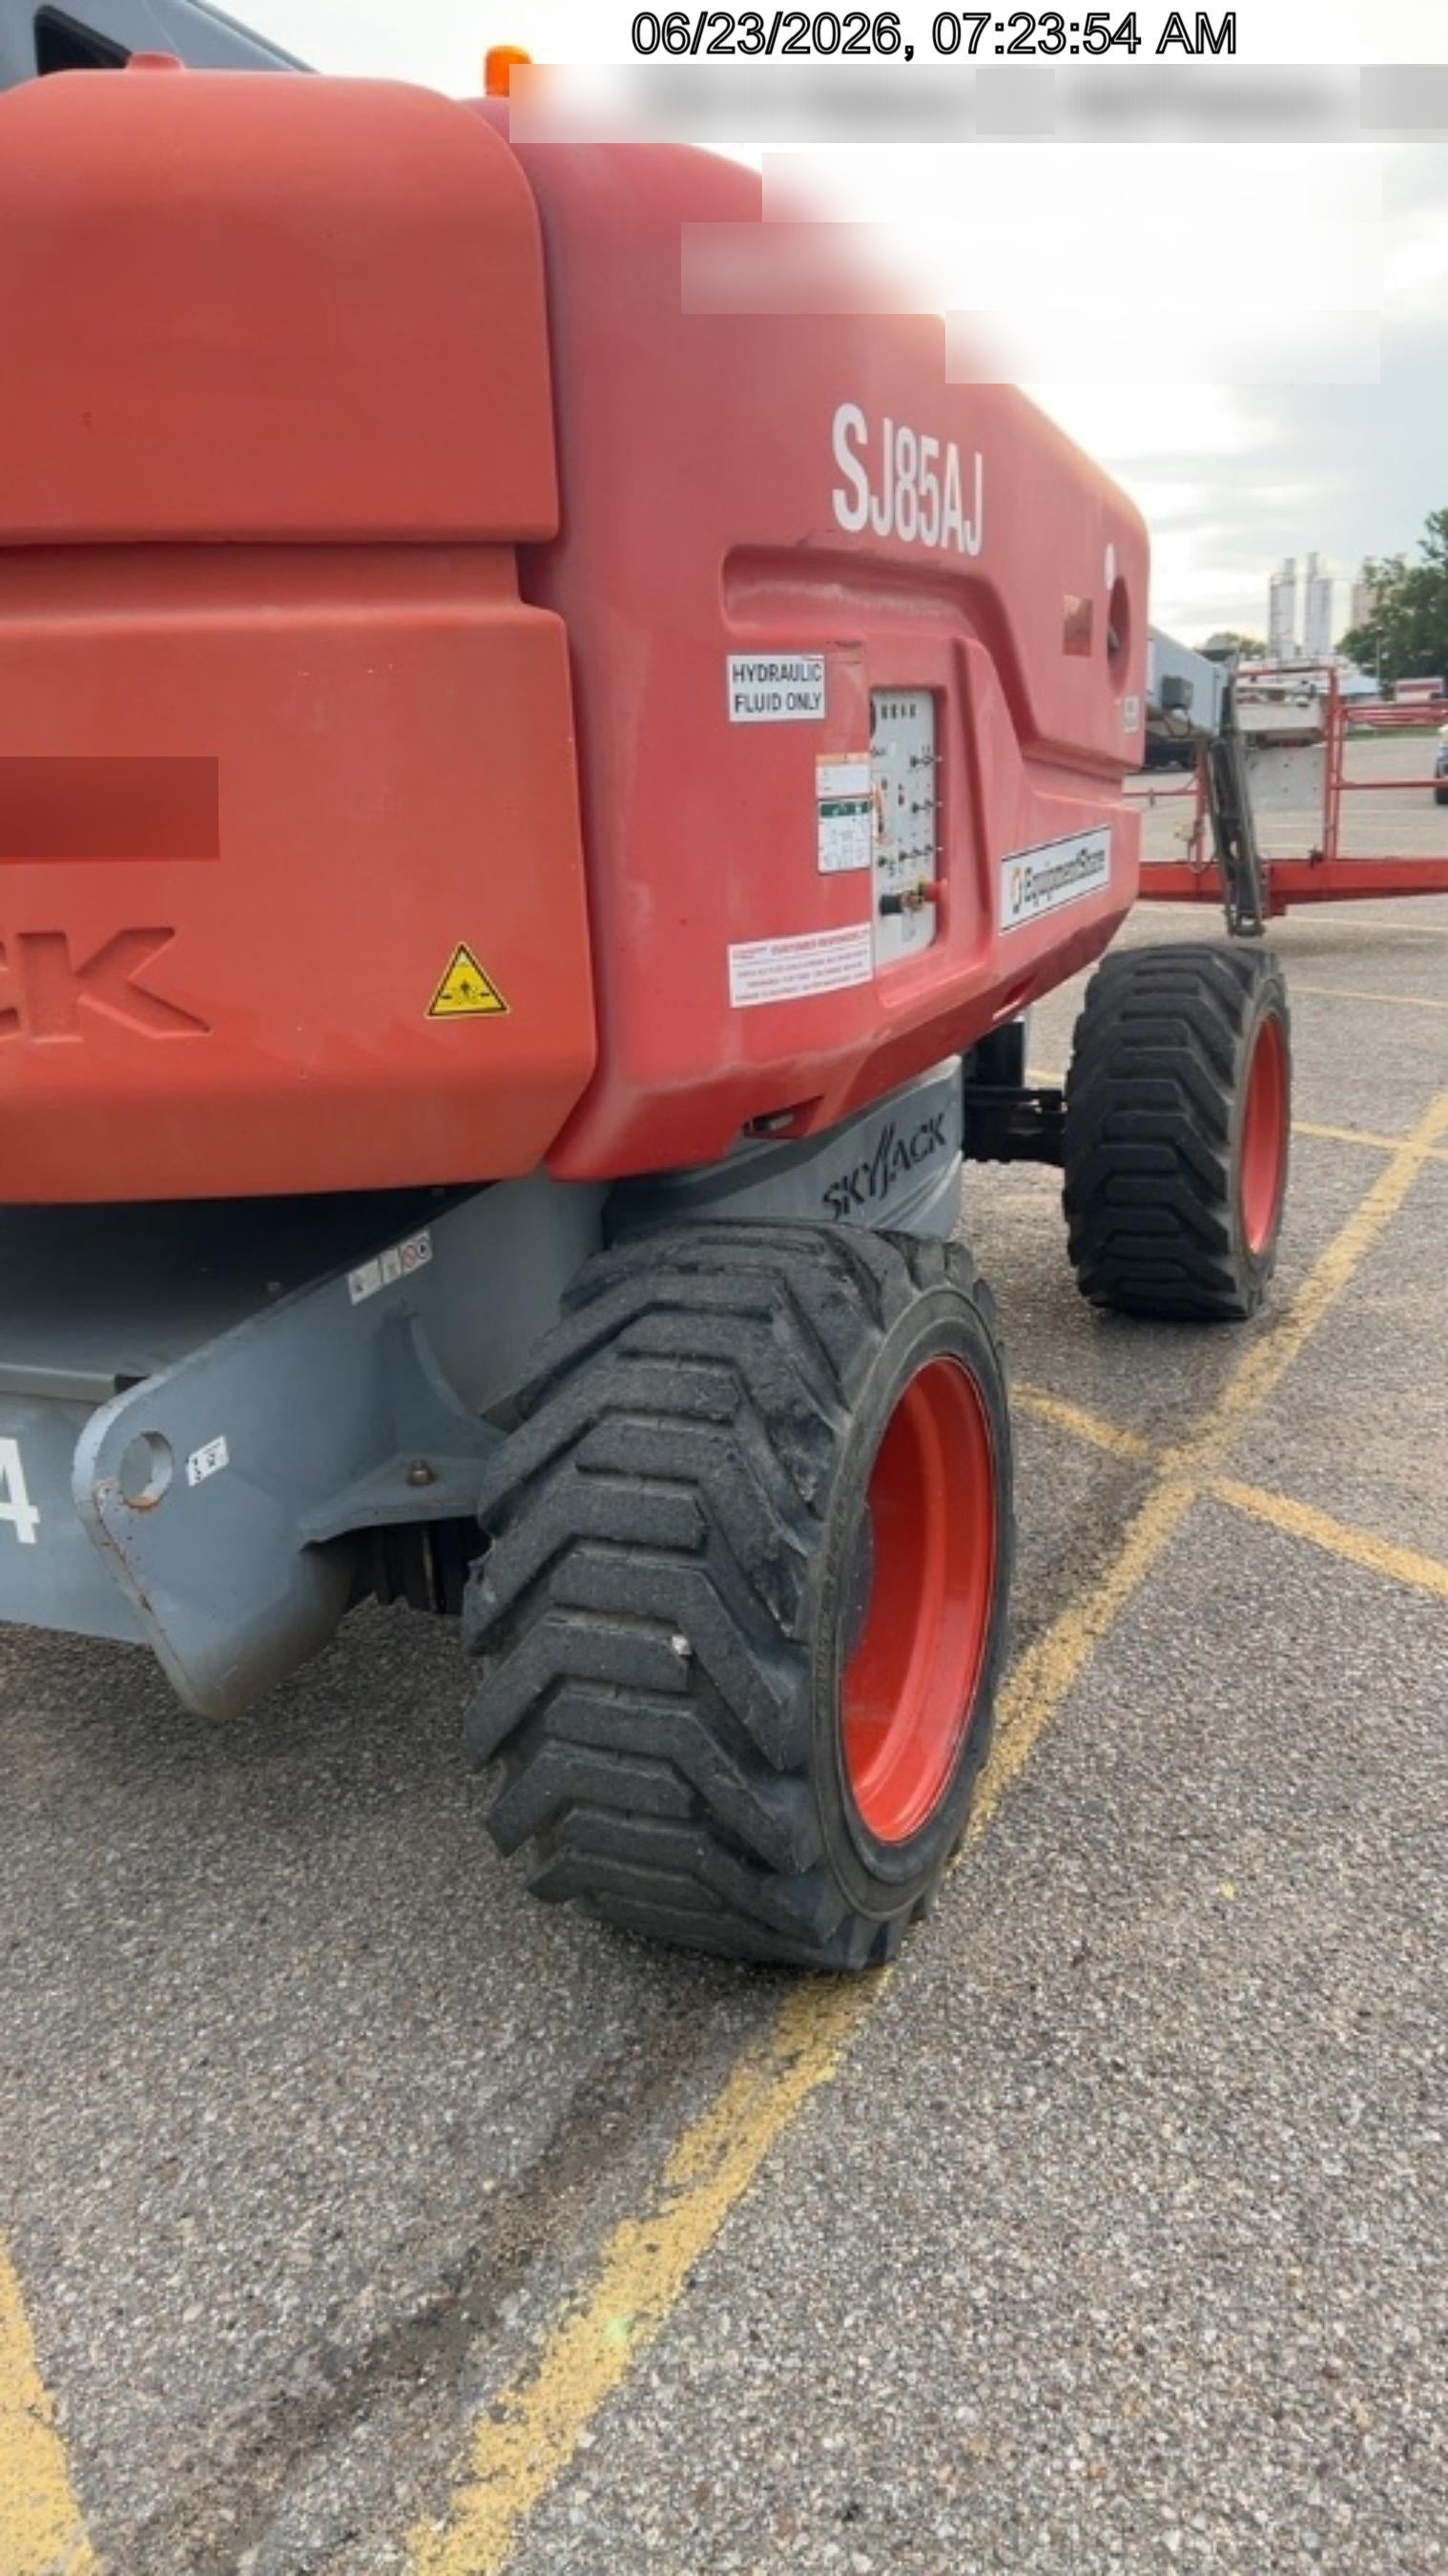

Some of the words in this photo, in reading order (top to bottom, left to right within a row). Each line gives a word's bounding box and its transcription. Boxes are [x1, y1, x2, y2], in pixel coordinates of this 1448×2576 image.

[832, 403, 983, 556] SJ85AJ
[733, 663, 822, 682] HYDRAULIC
[734, 693, 781, 713] FLUID
[787, 693, 822, 710] ONLY
[822, 1112, 946, 1221] SKYJACK
[0, 1437, 40, 1544] 4
